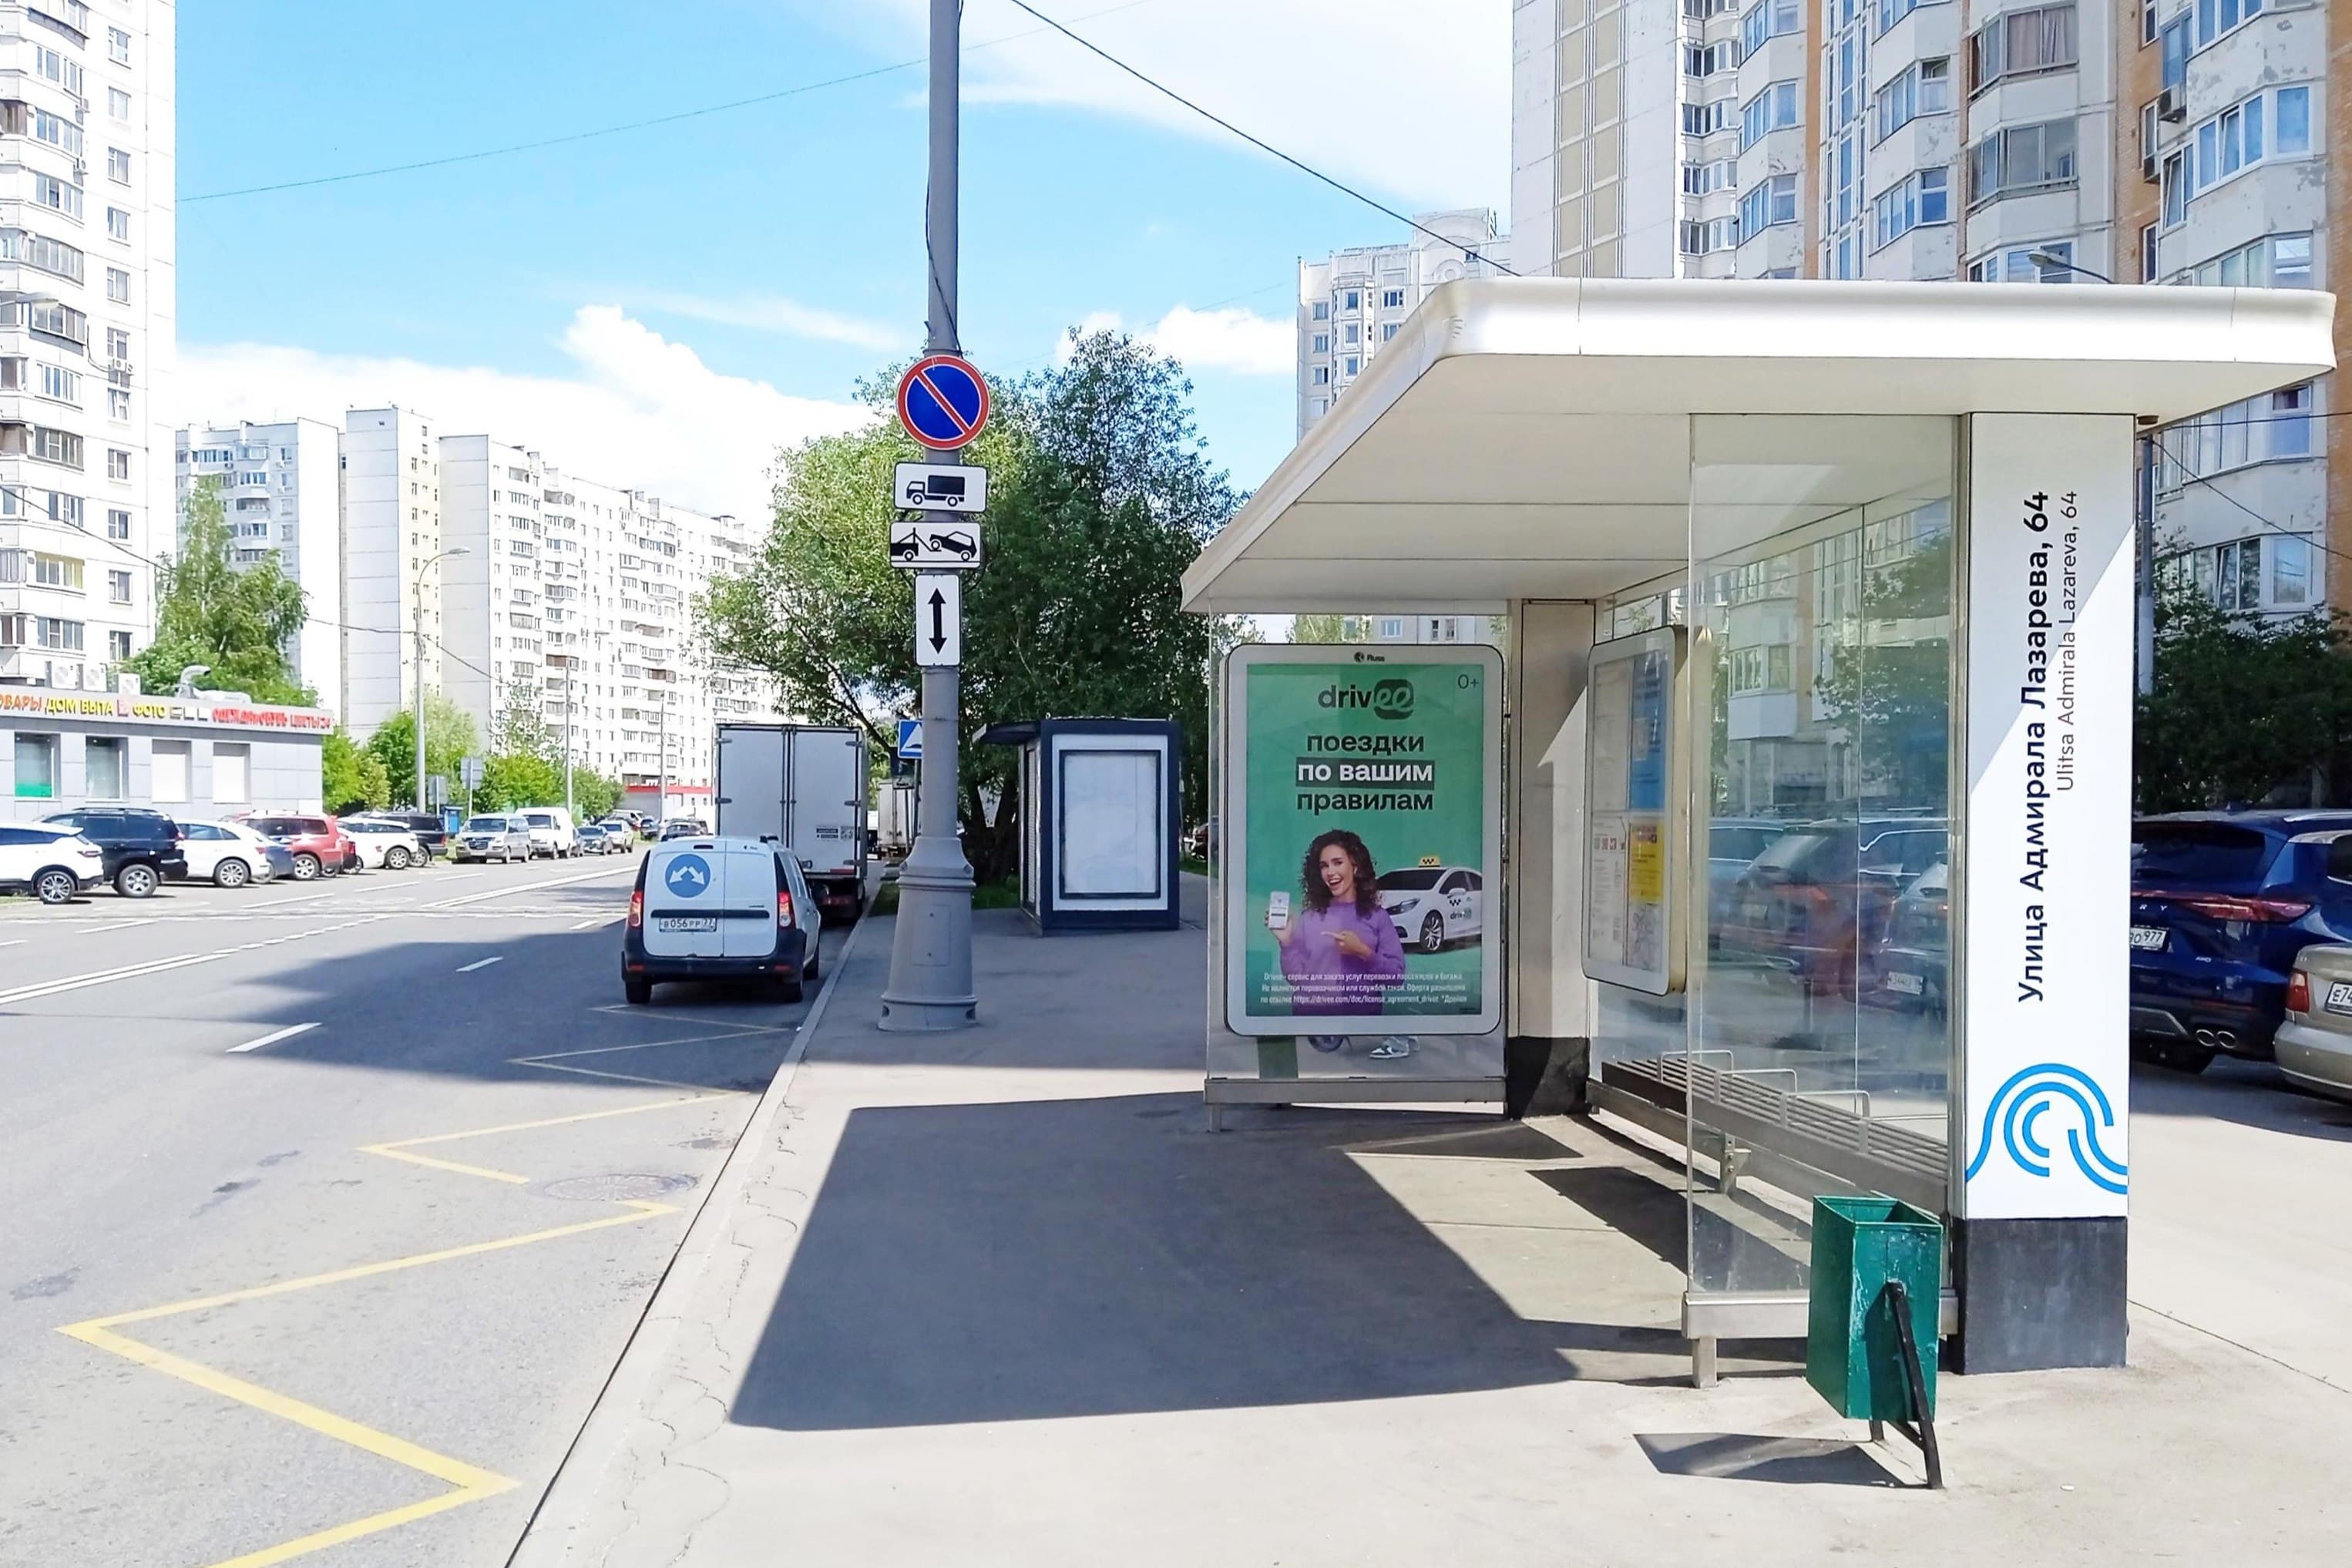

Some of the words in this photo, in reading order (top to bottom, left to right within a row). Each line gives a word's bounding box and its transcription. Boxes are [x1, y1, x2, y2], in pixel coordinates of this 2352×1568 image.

[2023, 491, 2048, 532] 64
[2061, 491, 2078, 519] 64
[2058, 525, 2079, 623] Lazareva,
[2021, 542, 2053, 710] Лазарева,
[1457, 673, 1480, 690] 0+
[2057, 631, 2075, 726] Admirala
[132, 702, 166, 719] ФОТО
[1318, 681, 1414, 717] drivee
[1306, 734, 1424, 757] поездки
[2057, 734, 2074, 791] Ulitsa
[1298, 764, 1332, 781] по
[1339, 764, 1433, 782] вашим
[1296, 793, 1433, 817] правилам
[2020, 722, 2051, 891] Адмирала
[2018, 904, 2048, 1002] Улица
